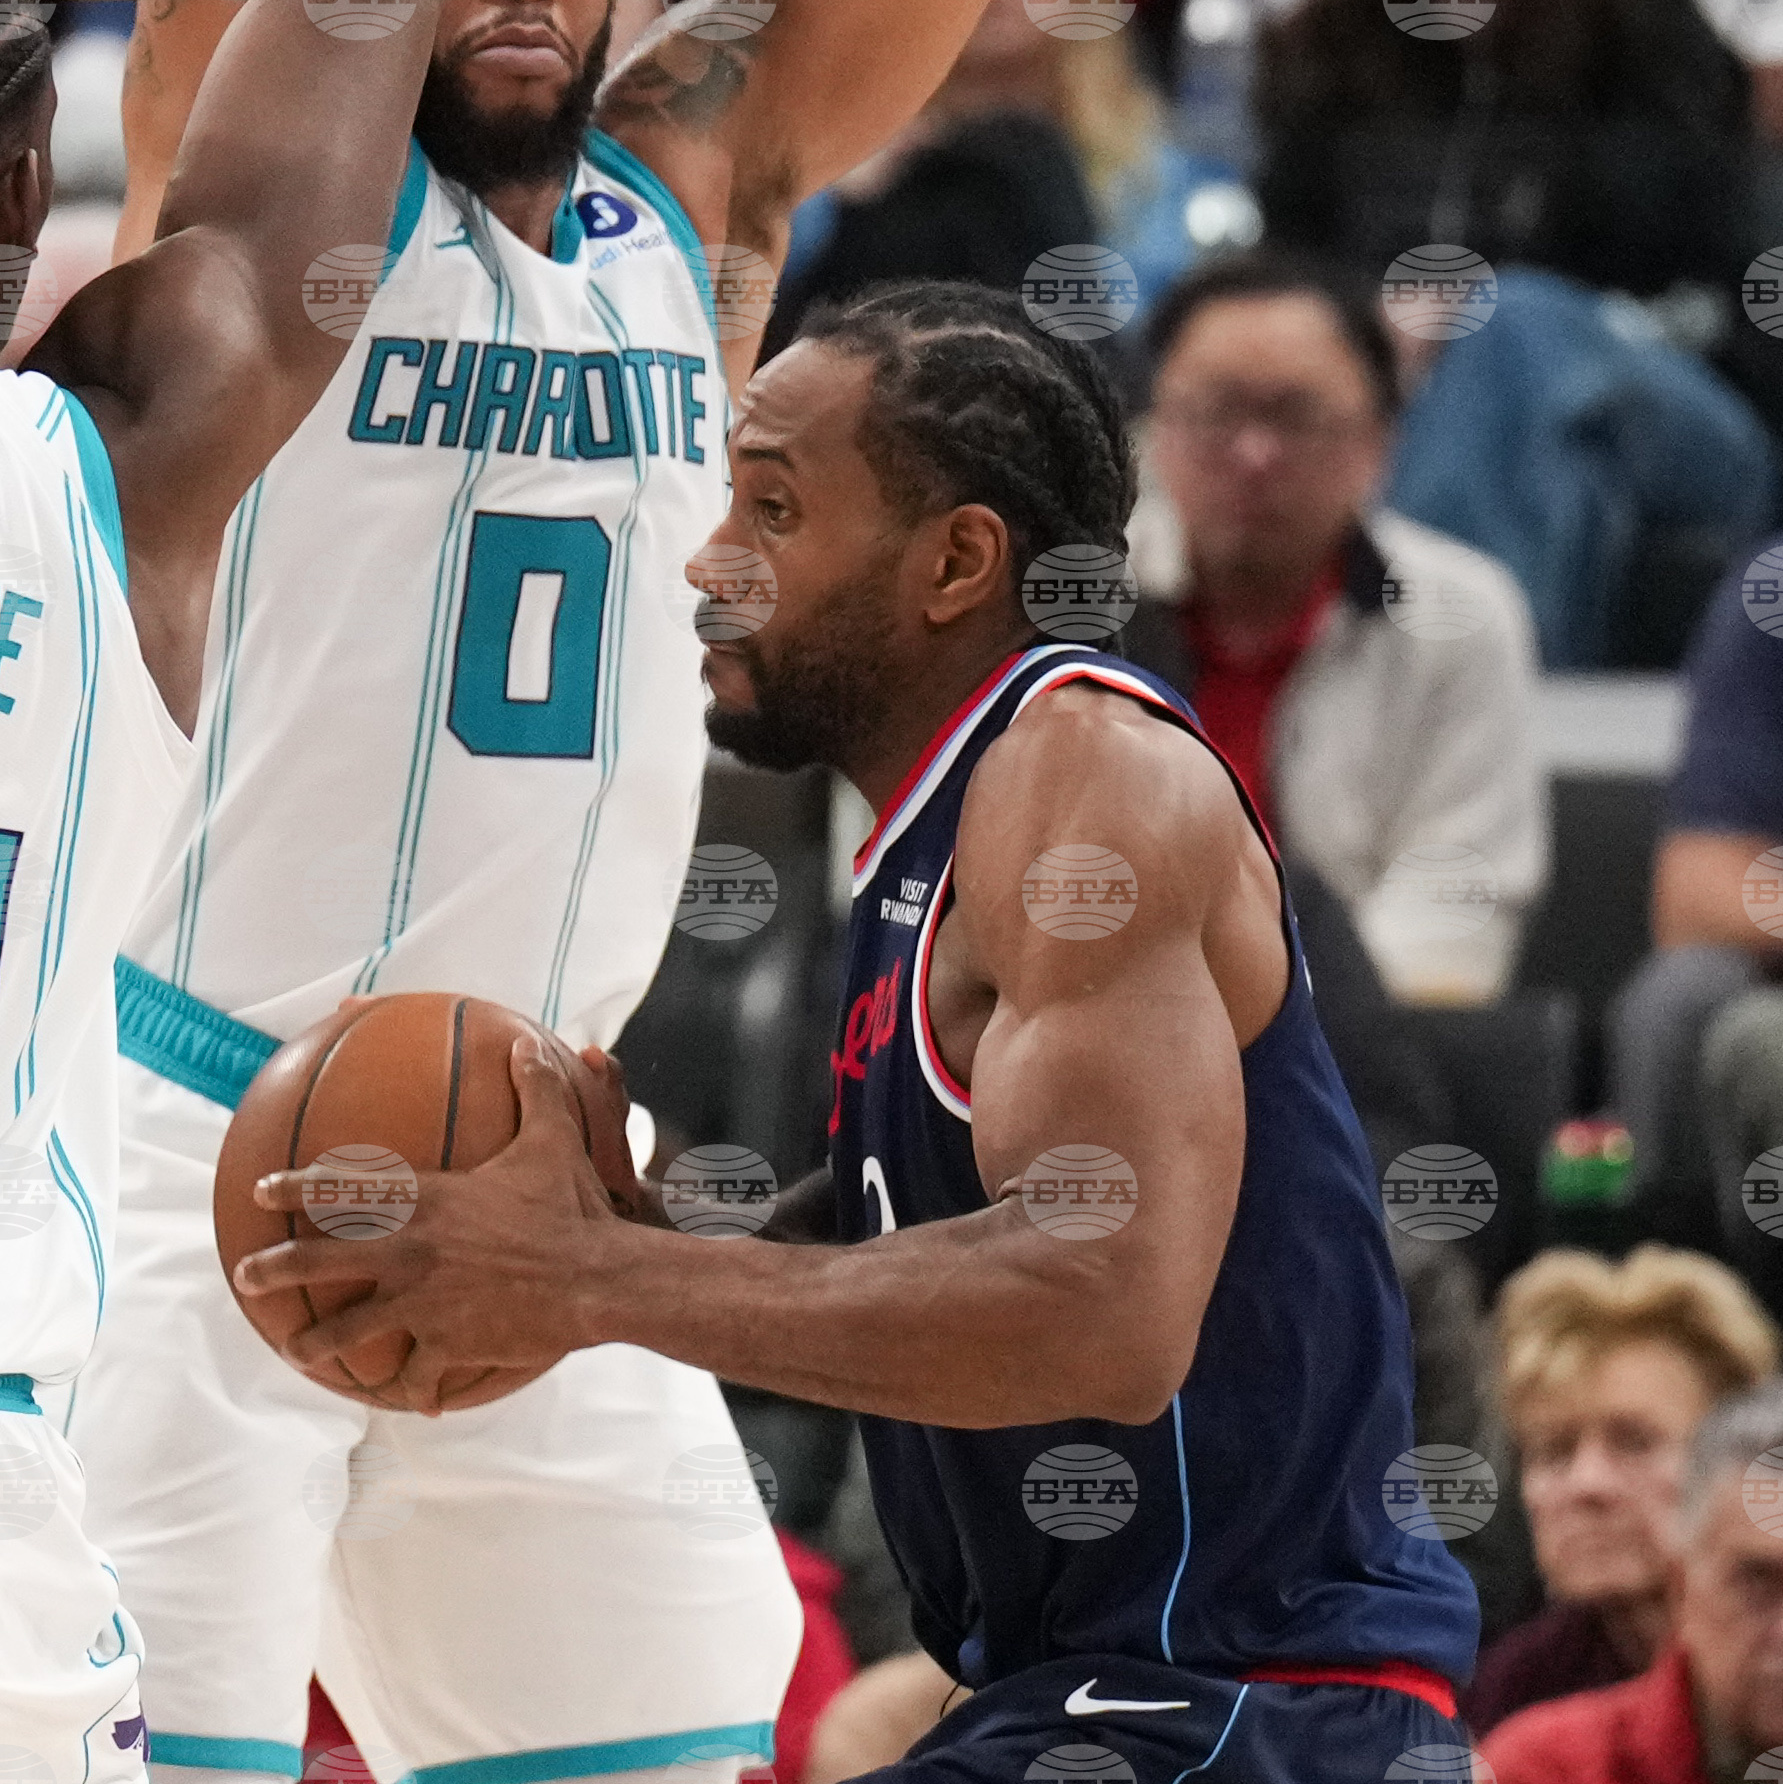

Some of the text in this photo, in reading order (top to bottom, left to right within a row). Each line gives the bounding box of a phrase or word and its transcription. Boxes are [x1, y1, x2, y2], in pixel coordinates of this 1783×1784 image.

[348, 336, 706, 466] CHAROTTE
[447, 510, 612, 761] 0
[899, 876, 929, 903] VISIT
